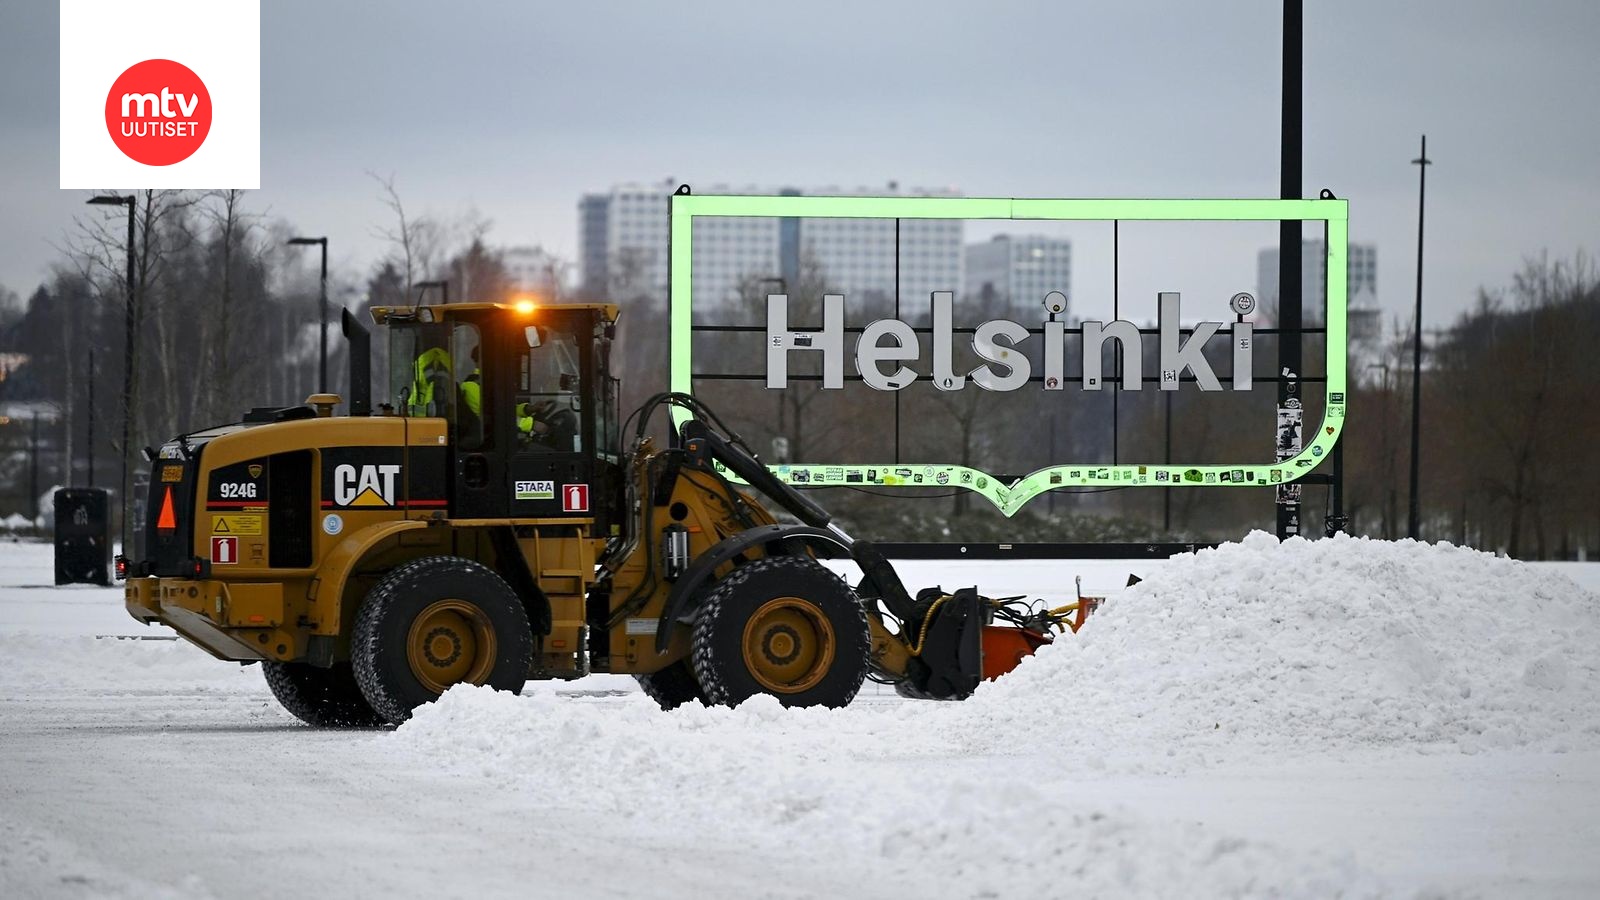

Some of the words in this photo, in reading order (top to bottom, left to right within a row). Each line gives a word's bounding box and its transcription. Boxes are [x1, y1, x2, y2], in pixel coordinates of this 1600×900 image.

[766, 291, 1256, 392] Helsinki
[220, 482, 257, 498] 924G
[334, 464, 400, 506] CAT
[517, 482, 552, 492] STARA
